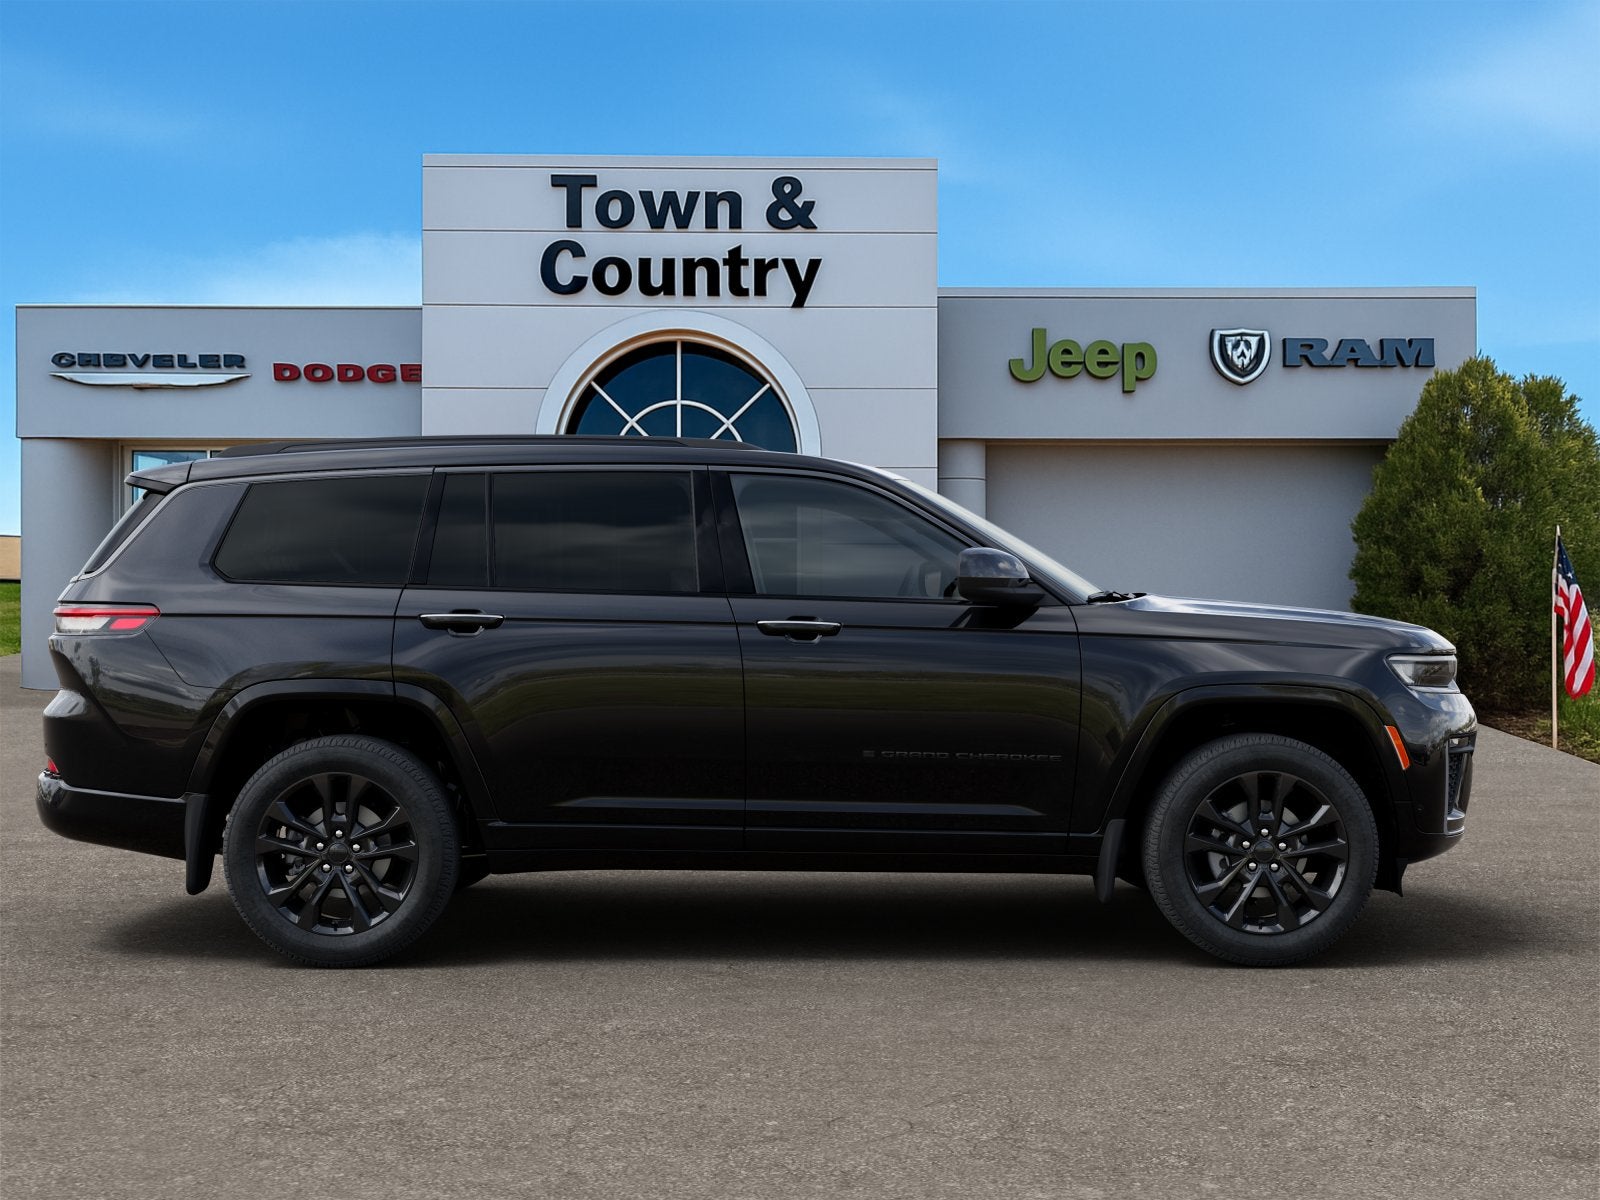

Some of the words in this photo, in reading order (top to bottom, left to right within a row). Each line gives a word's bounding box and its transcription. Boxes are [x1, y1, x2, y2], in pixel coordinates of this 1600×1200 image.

[550, 174, 742, 229] Town
[765, 175, 818, 230] &
[540, 239, 822, 308] Country
[272, 362, 422, 383] DODGE
[1008, 327, 1158, 393] Jeep
[1282, 337, 1435, 368] RAM
[881, 750, 950, 759] GRAND
[955, 752, 1063, 762] CHEROKEE
